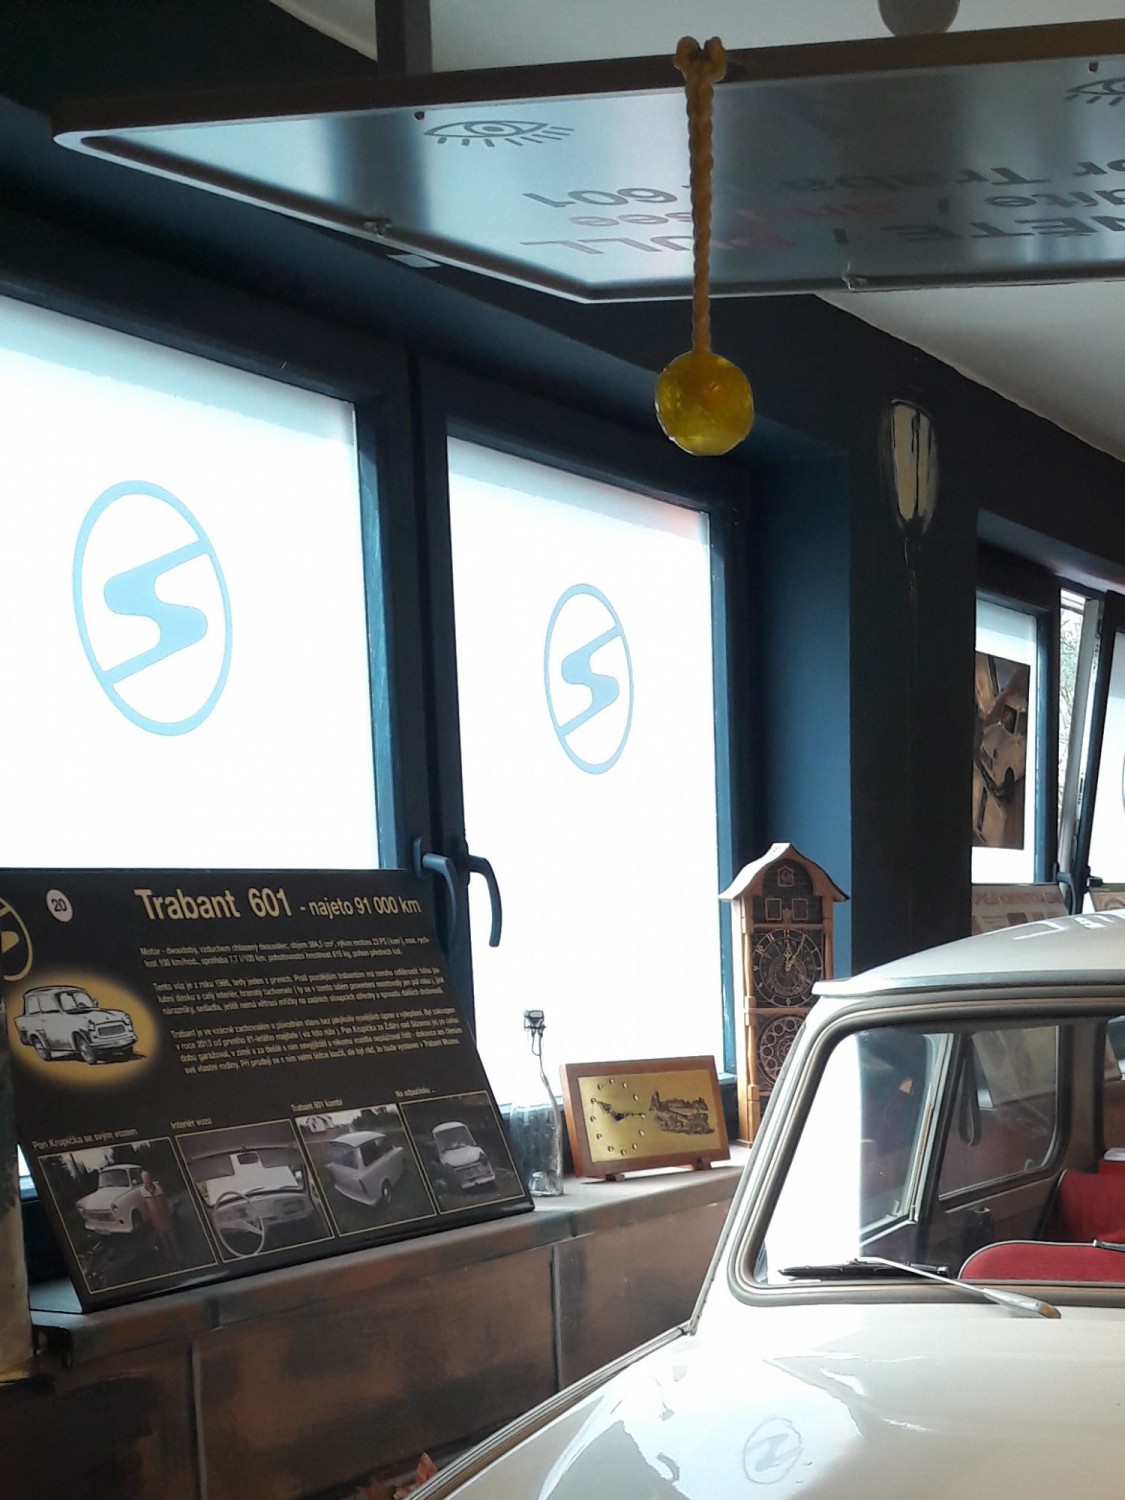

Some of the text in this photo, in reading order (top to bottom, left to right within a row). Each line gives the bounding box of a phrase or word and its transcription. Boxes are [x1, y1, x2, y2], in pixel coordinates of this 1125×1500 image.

[523, 186, 678, 208] 601
[51, 898, 67, 912] 20
[133, 888, 241, 920] Trabant
[248, 887, 293, 917] 601
[309, 897, 353, 920] najeto
[355, 896, 372, 915] 91
[373, 896, 398, 914] 000
[399, 895, 422, 914] km
[170, 1118, 195, 1129] Interiér
[32, 1140, 49, 1149] Pan
[49, 1133, 84, 1149] Krupička
[84, 1134, 93, 1143] se
